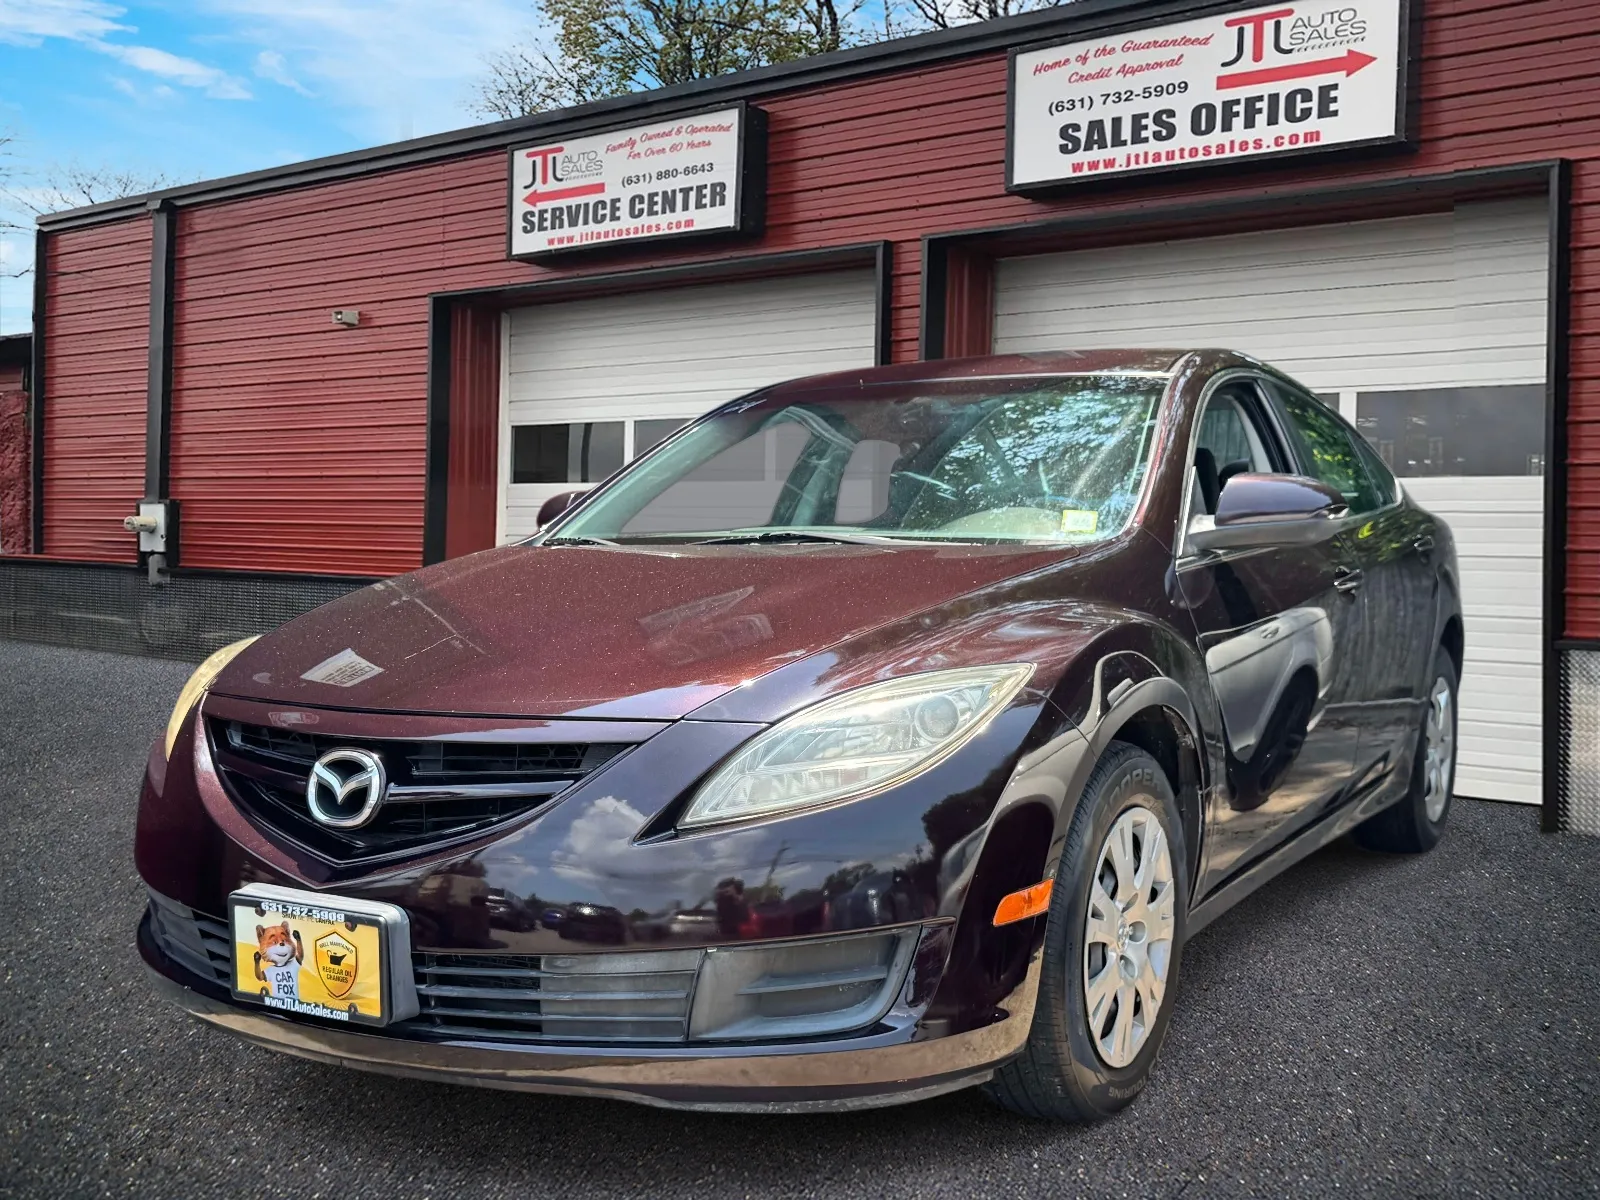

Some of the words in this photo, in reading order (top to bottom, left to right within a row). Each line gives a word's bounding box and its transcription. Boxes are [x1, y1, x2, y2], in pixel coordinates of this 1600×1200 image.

[1220, 8, 1295, 68] JTL
[1290, 8, 1358, 32] AUTO
[1289, 20, 1367, 46] SALES
[1033, 57, 1071, 76] Home
[1075, 49, 1090, 65] of
[1094, 45, 1116, 59] the
[1121, 33, 1215, 53] Guaranteed
[1068, 71, 1113, 84] Credit
[1115, 54, 1184, 78] Approval
[1048, 96, 1094, 116] (631)
[1100, 80, 1189, 105] 732-5909
[1059, 109, 1177, 155] SALES
[1190, 83, 1339, 138] OFFICE
[605, 137, 637, 154] Family
[640, 128, 675, 143] Owned
[675, 126, 683, 136] &
[685, 123, 734, 136] Operated
[627, 151, 641, 160] For
[644, 147, 667, 158] Over
[669, 142, 683, 153] 60
[686, 140, 712, 149] Years
[1071, 129, 1321, 174] www.jtlautosales.com
[523, 146, 564, 190] JTL
[561, 150, 598, 166] AUTO
[561, 160, 603, 177] SALES
[621, 172, 652, 188] (631)
[656, 162, 714, 181] 880-6643
[522, 198, 621, 234] SERVICE
[628, 181, 727, 219] CENTER
[547, 218, 695, 246] www.jtlautosales.com
[261, 901, 345, 922] 631-732-5909
[275, 971, 294, 983] CAR
[322, 966, 344, 976] REGULAR
[327, 974, 349, 984] CHANGES
[277, 984, 295, 996] FOX
[264, 996, 349, 1021] www.JTLAutoSales.com
[1108, 1075, 1146, 1099] TOURING
